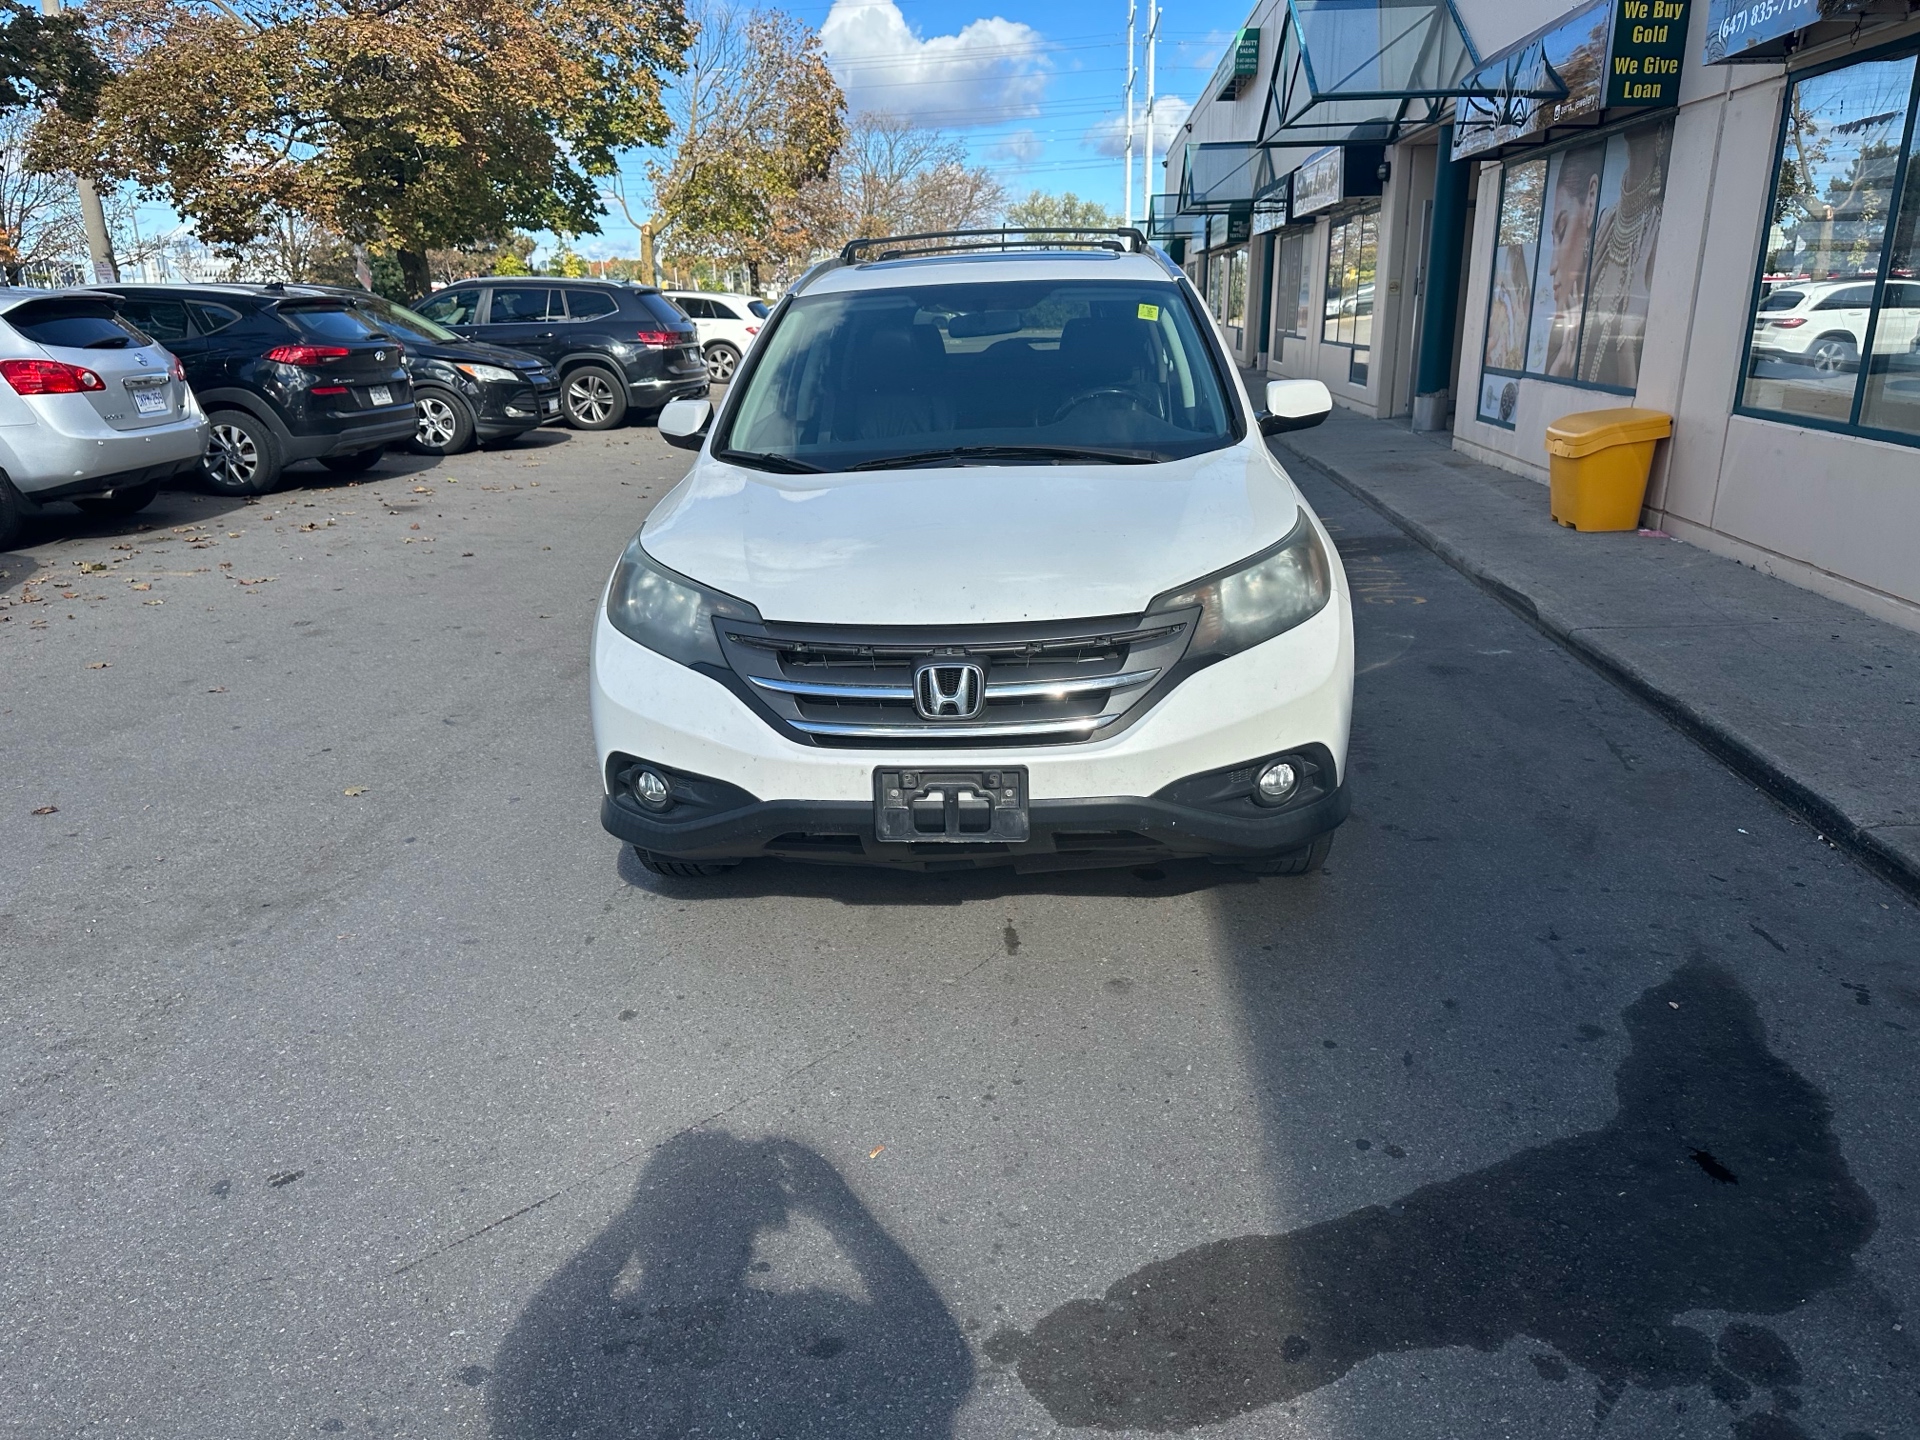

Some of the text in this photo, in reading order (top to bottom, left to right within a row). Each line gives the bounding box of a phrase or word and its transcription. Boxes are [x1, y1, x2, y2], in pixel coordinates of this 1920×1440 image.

[1624, 0, 1684, 20] We Buy
[1632, 25, 1669, 43] Gold
[1718, 10, 1748, 43] (647)
[1615, 56, 1679, 75] We Give
[1623, 81, 1662, 98] Loan
